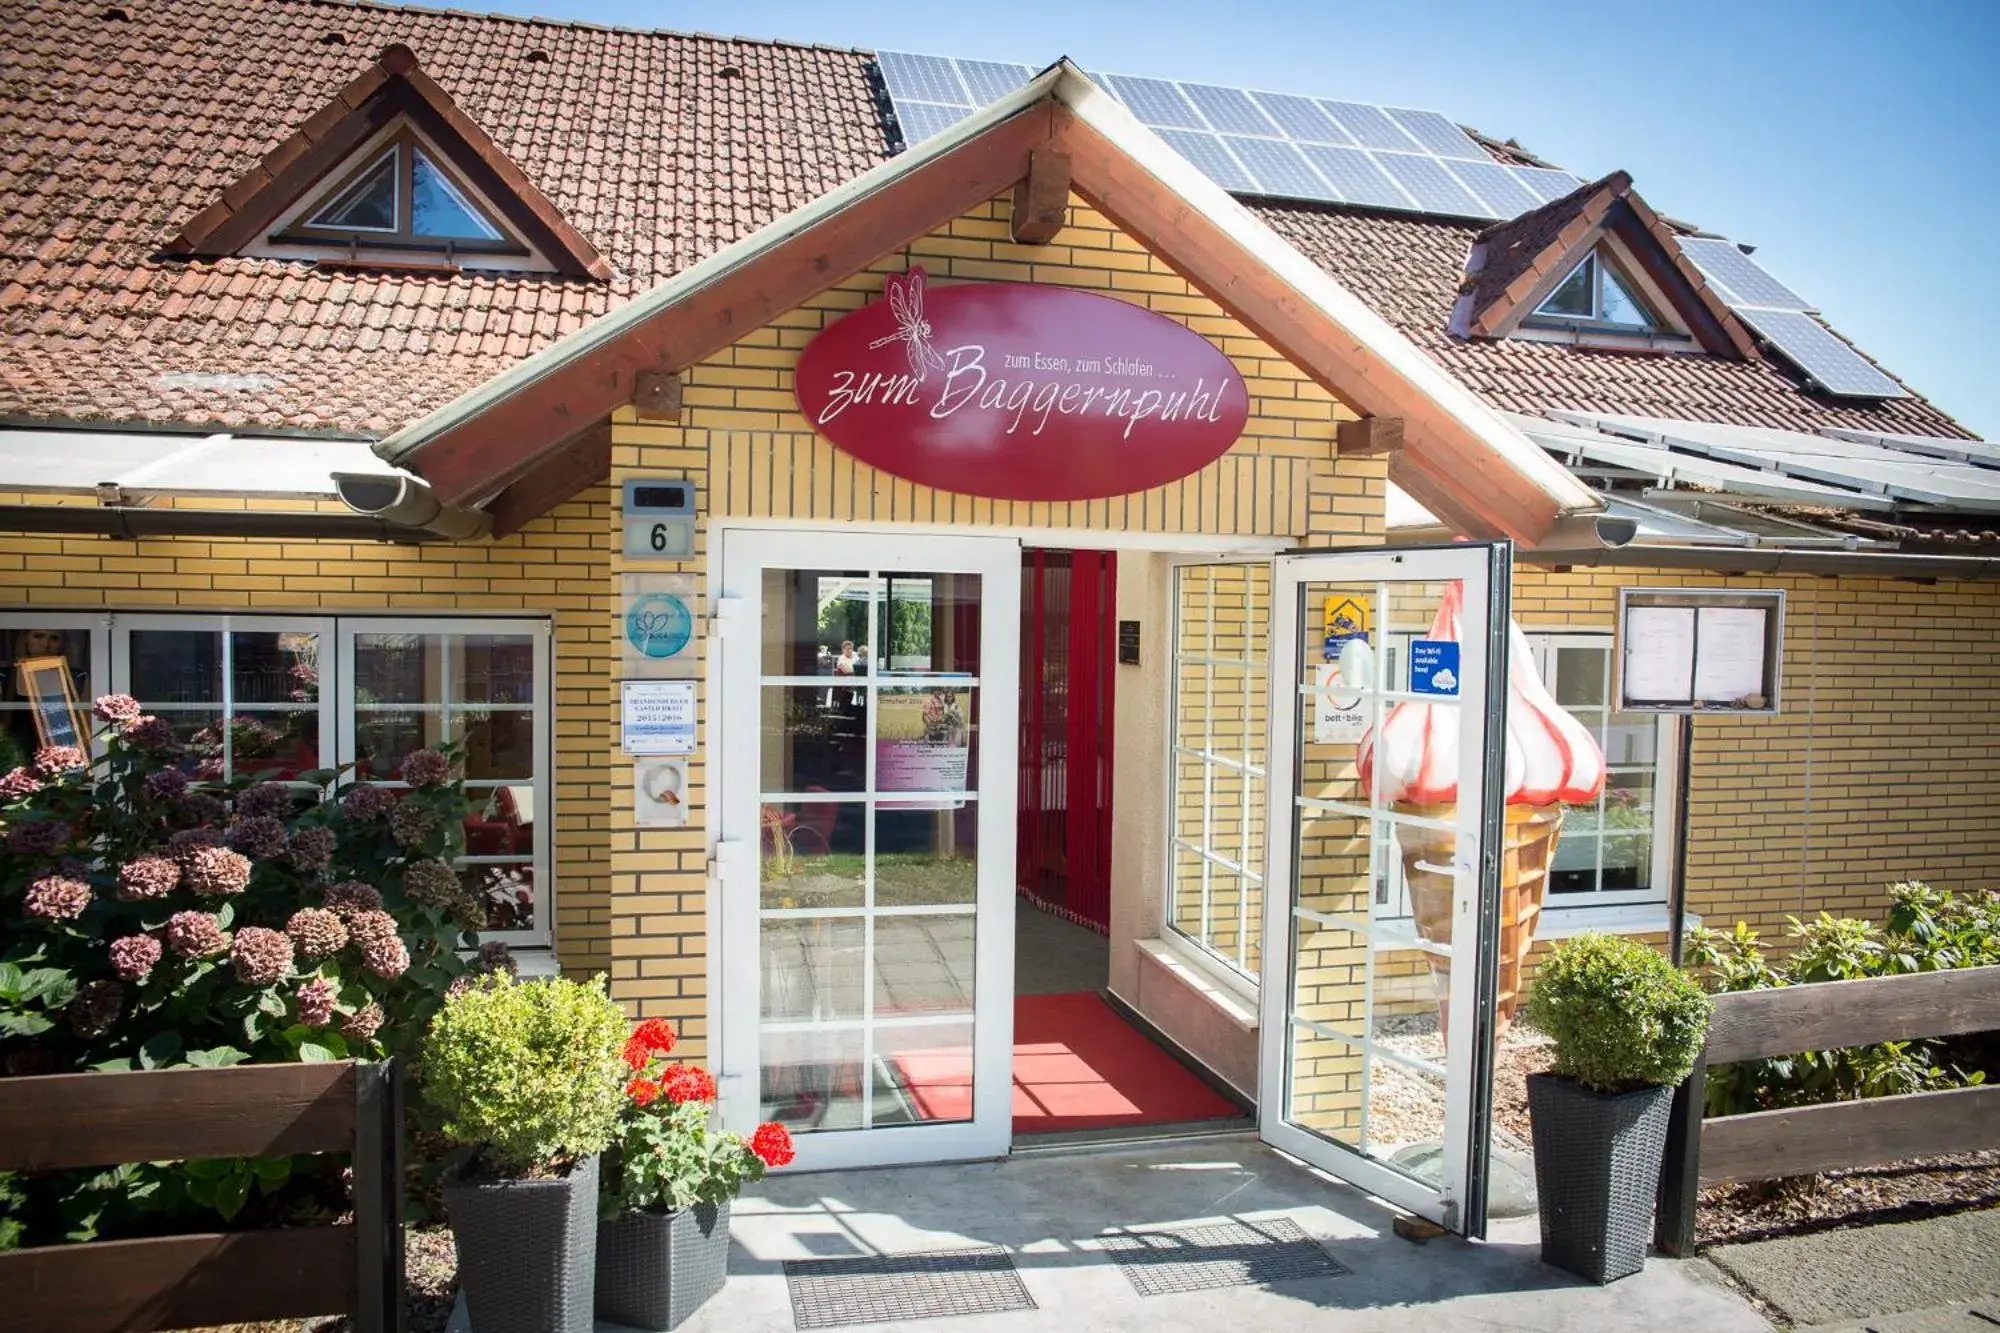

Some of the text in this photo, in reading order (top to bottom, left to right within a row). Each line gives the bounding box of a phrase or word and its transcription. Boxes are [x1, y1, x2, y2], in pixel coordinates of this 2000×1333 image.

[1004, 354, 1031, 369] zum
[1034, 351, 1072, 374] Essen,
[1075, 358, 1101, 374] zum
[1104, 356, 1153, 377] Schlafen
[818, 345, 1228, 438] zum Baggernpuhl
[650, 523, 667, 552] 6
